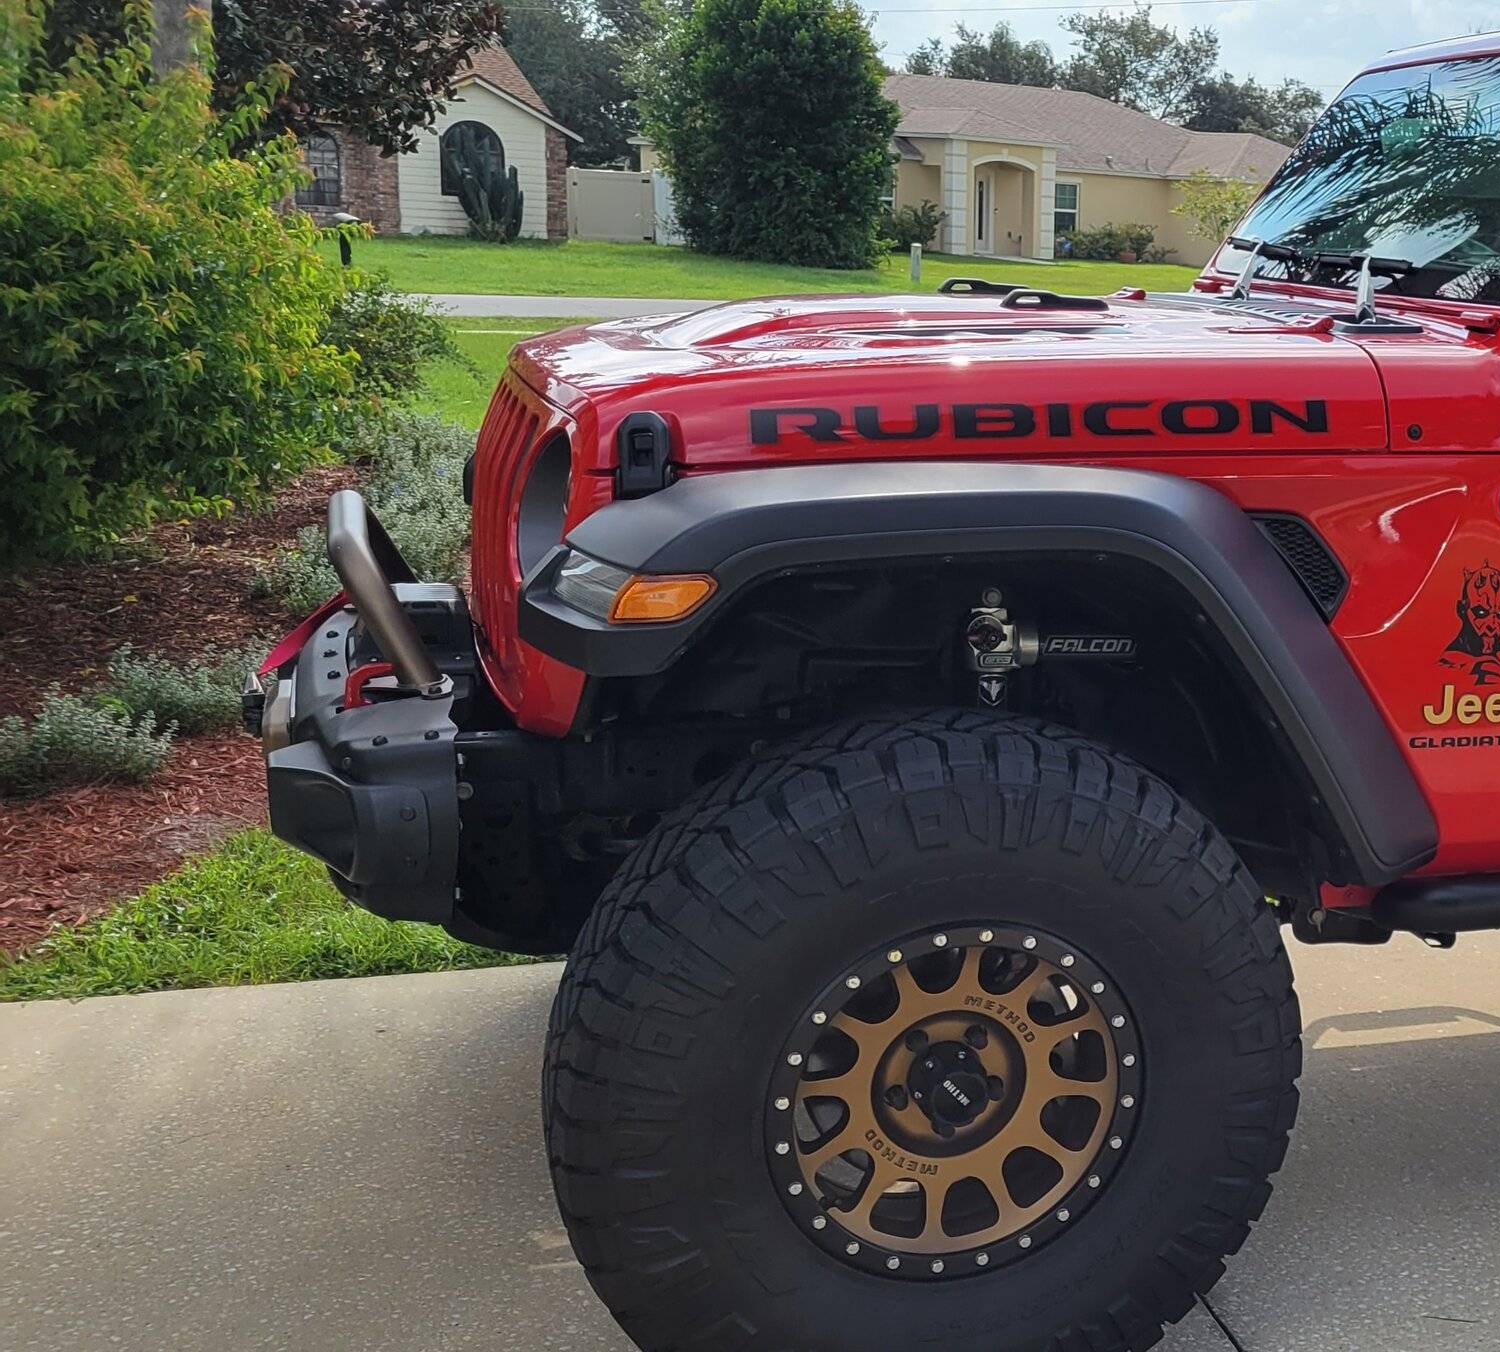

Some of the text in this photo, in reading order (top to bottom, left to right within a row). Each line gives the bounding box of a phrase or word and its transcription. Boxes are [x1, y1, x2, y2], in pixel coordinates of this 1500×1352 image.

[749, 398, 1330, 445] RUBICON
[1049, 638, 1133, 653] FALCON
[964, 995, 1036, 1043] METHOD
[865, 1129, 938, 1175] METHOD
